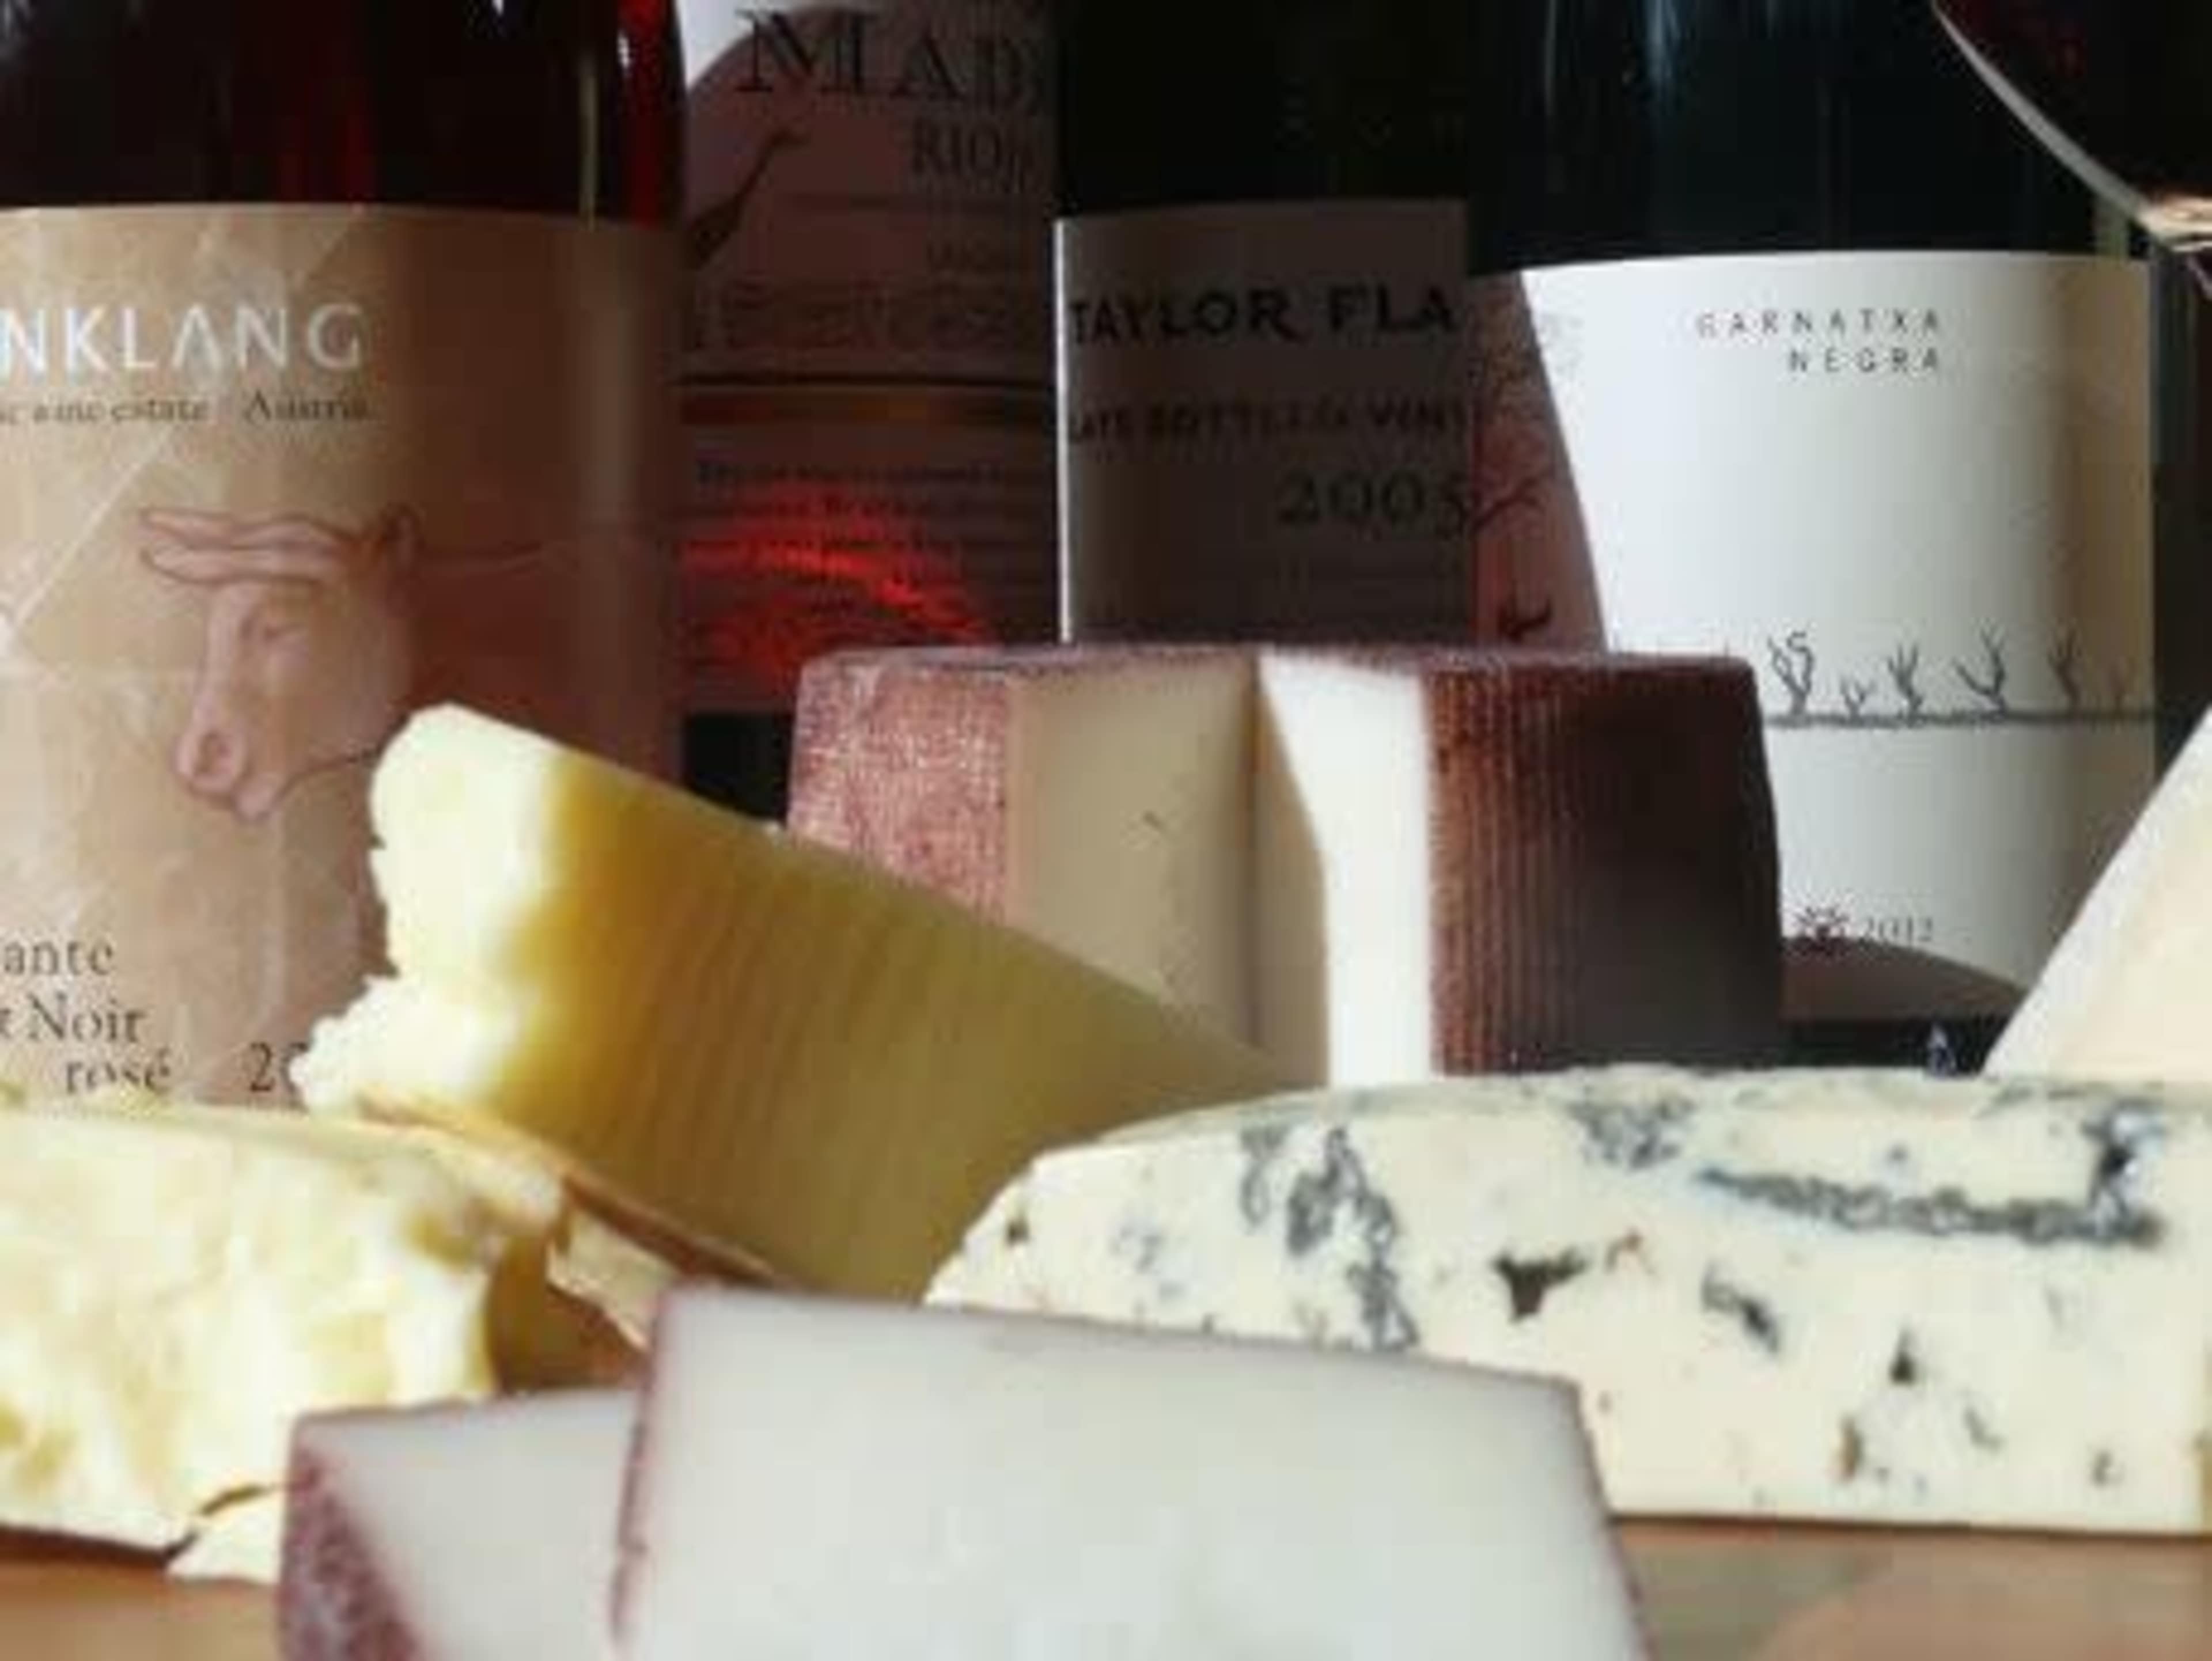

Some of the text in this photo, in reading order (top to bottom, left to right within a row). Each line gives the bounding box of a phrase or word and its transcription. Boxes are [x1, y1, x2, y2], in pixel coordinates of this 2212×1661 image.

[0, 304, 366, 371] NKLANG
[1070, 288, 1305, 343] TAYLOR
[1327, 284, 1459, 335] FLA
[1788, 347, 1939, 373] NEGRA
[29, 992, 147, 1041] Noir
